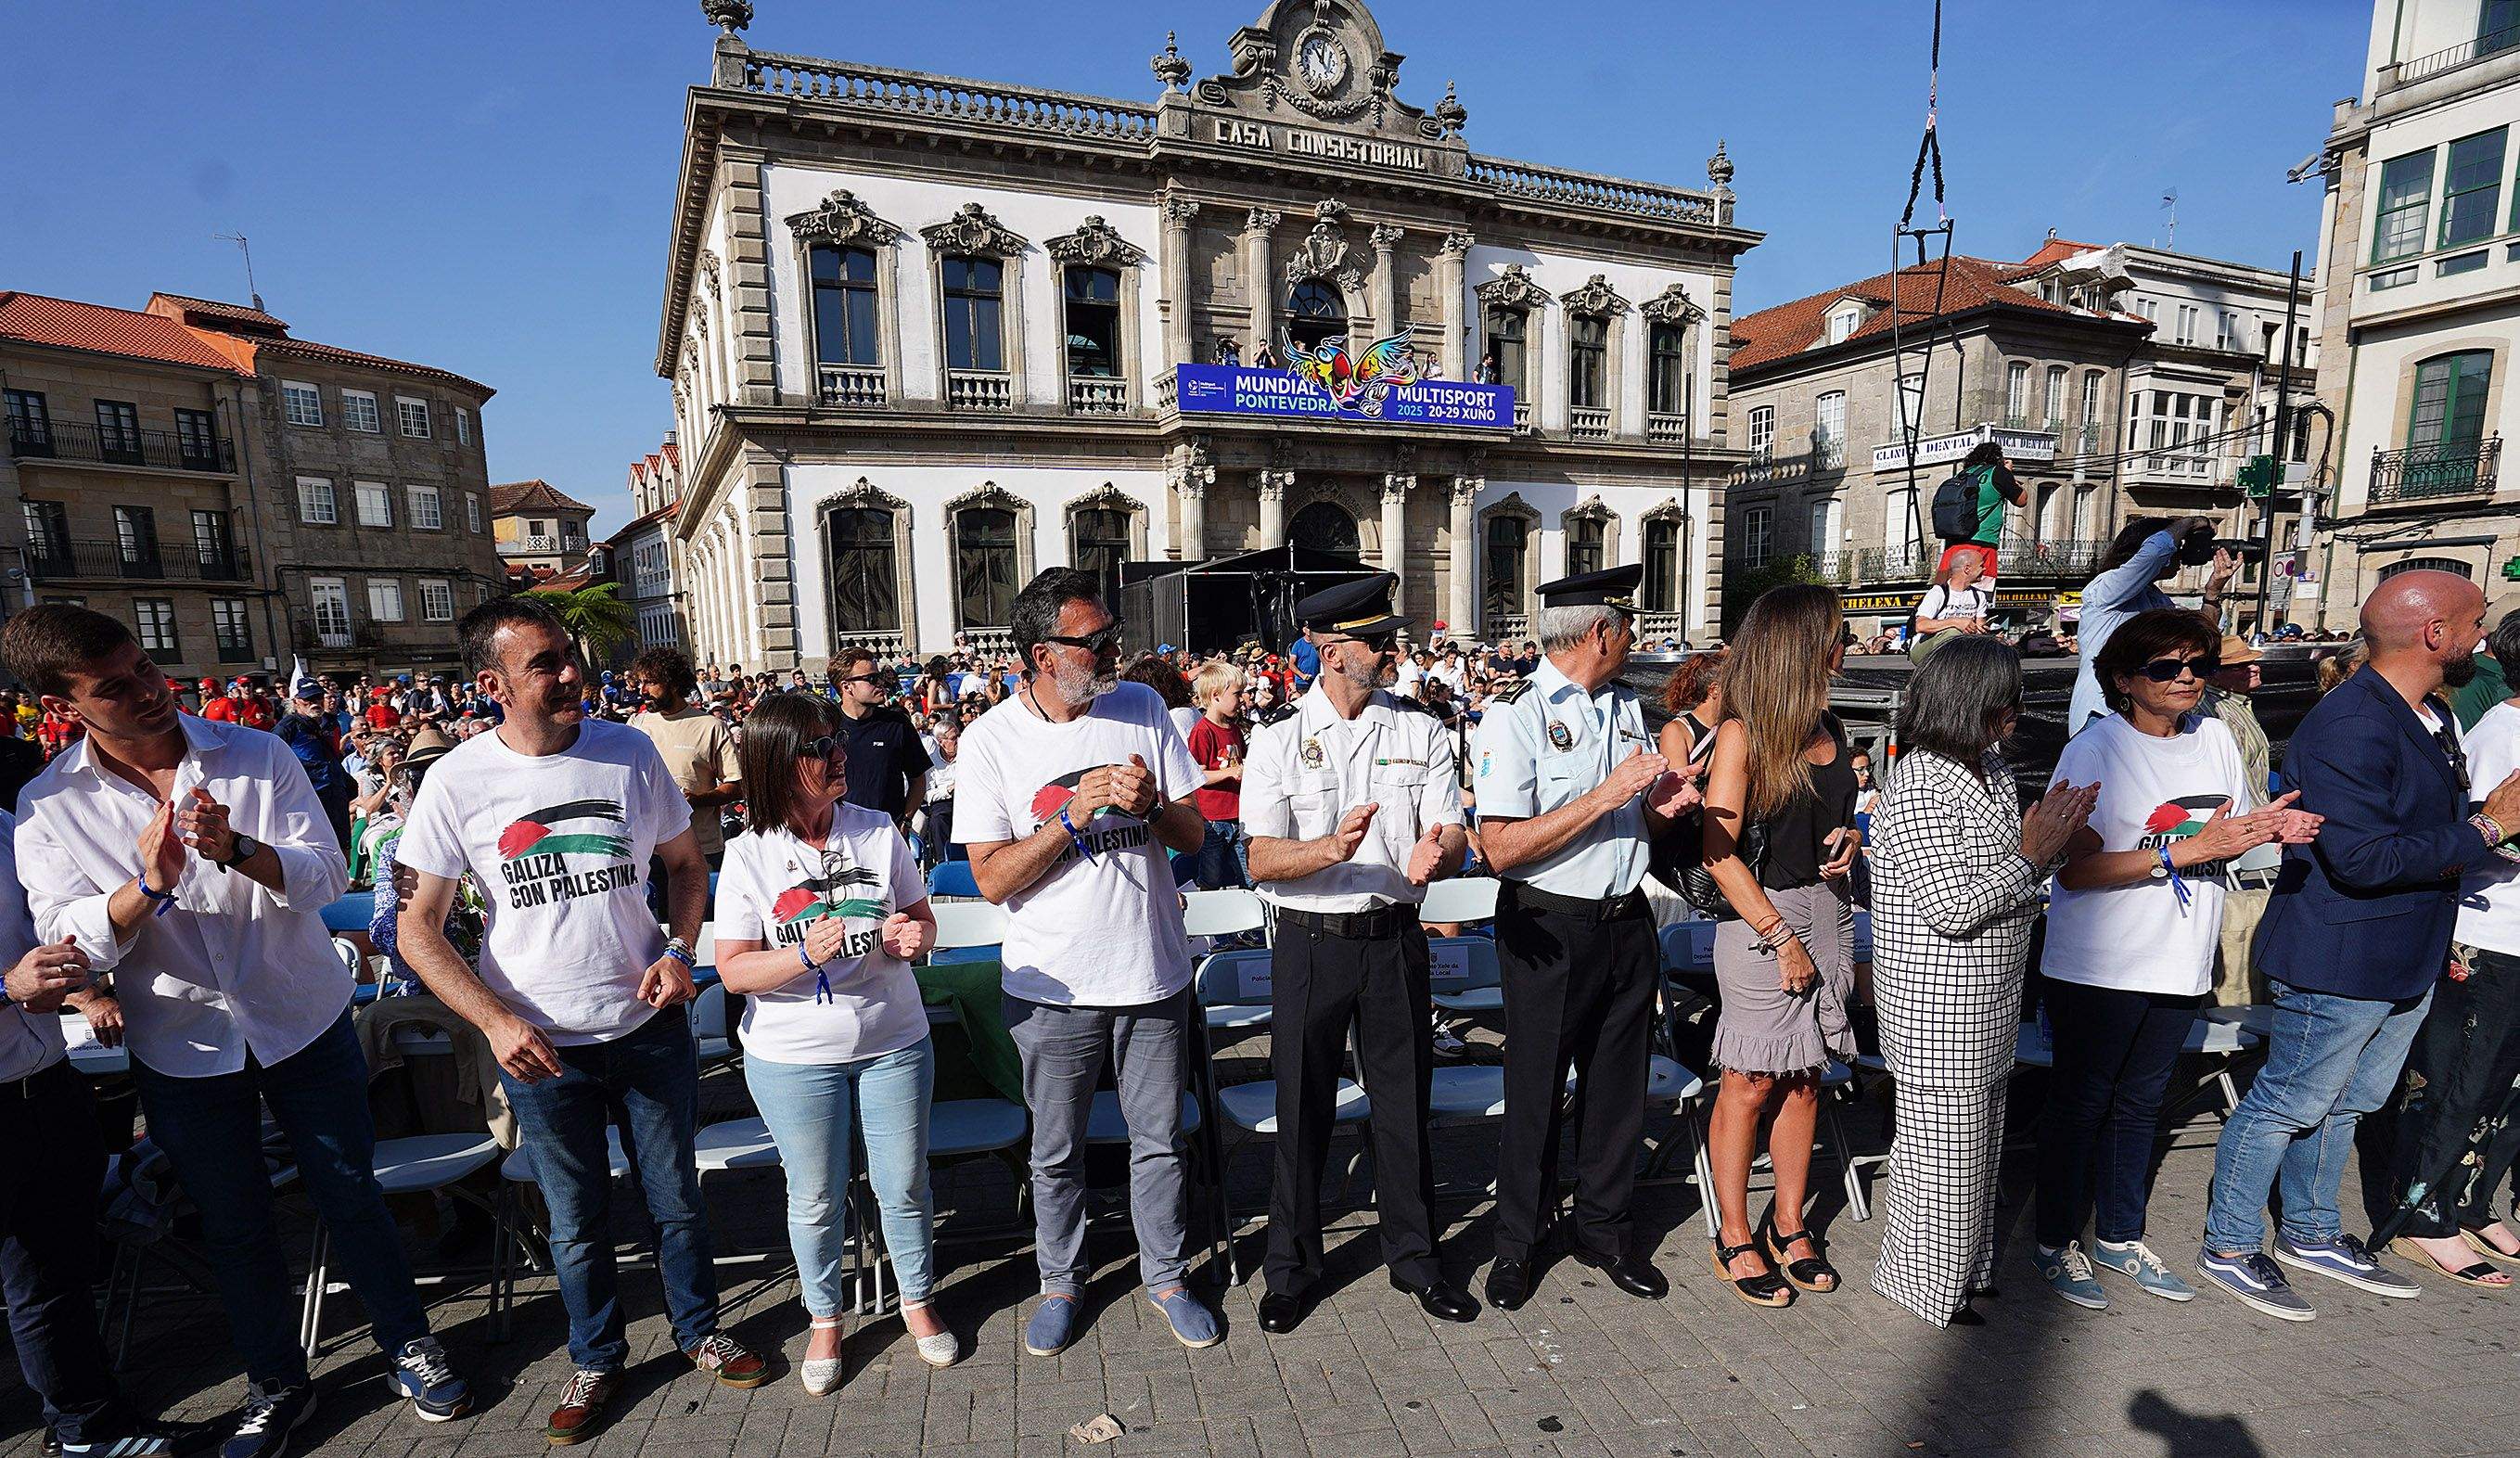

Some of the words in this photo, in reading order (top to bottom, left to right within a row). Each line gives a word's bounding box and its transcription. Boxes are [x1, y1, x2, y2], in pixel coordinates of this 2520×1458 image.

[1215, 120, 1270, 147] CASA
[1287, 130, 1425, 169] CONSISTORIAL
[1235, 375, 1319, 396] MUNDIAL
[1235, 393, 1338, 412] PONTEVEDRA
[1397, 387, 1496, 407] MULTISPORT
[1398, 404, 1423, 416] 2025
[1428, 405, 1460, 418] 20-29
[1462, 405, 1496, 421] XUÑO
[1926, 437, 1974, 453] DENTAL
[1841, 596, 1901, 608] CHELENA
[502, 852, 568, 884] GALIZA
[510, 882, 546, 909] CON
[549, 863, 638, 901] PALESTINA
